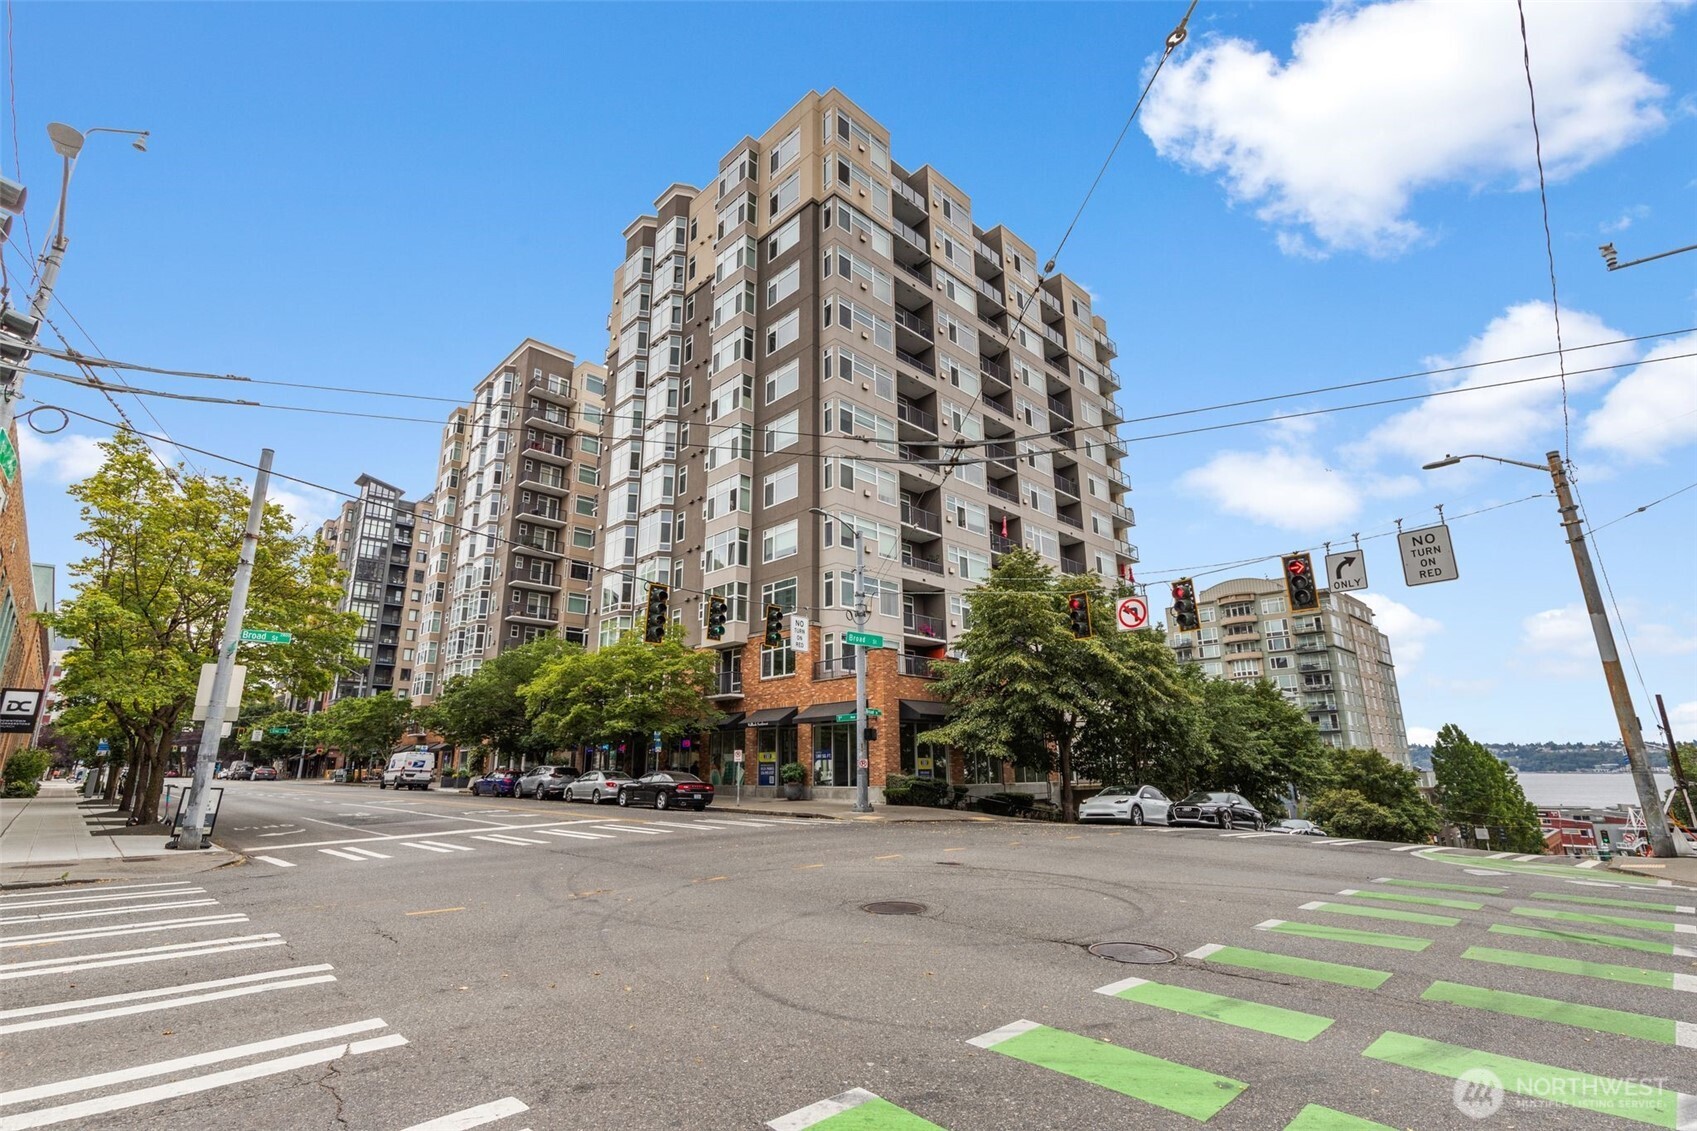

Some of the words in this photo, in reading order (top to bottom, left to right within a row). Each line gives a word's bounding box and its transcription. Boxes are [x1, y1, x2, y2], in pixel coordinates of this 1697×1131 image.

[1412, 534, 1435, 547] NO
[1411, 546, 1441, 558] TURN
[1421, 558, 1436, 567] ON
[1419, 568, 1442, 579] RED
[1334, 578, 1361, 590] ONLY
[242, 630, 267, 640] Broad
[794, 627, 806, 635] TURN
[848, 633, 866, 644] Broad
[795, 641, 804, 649] RED
[6, 700, 32, 712] DC
